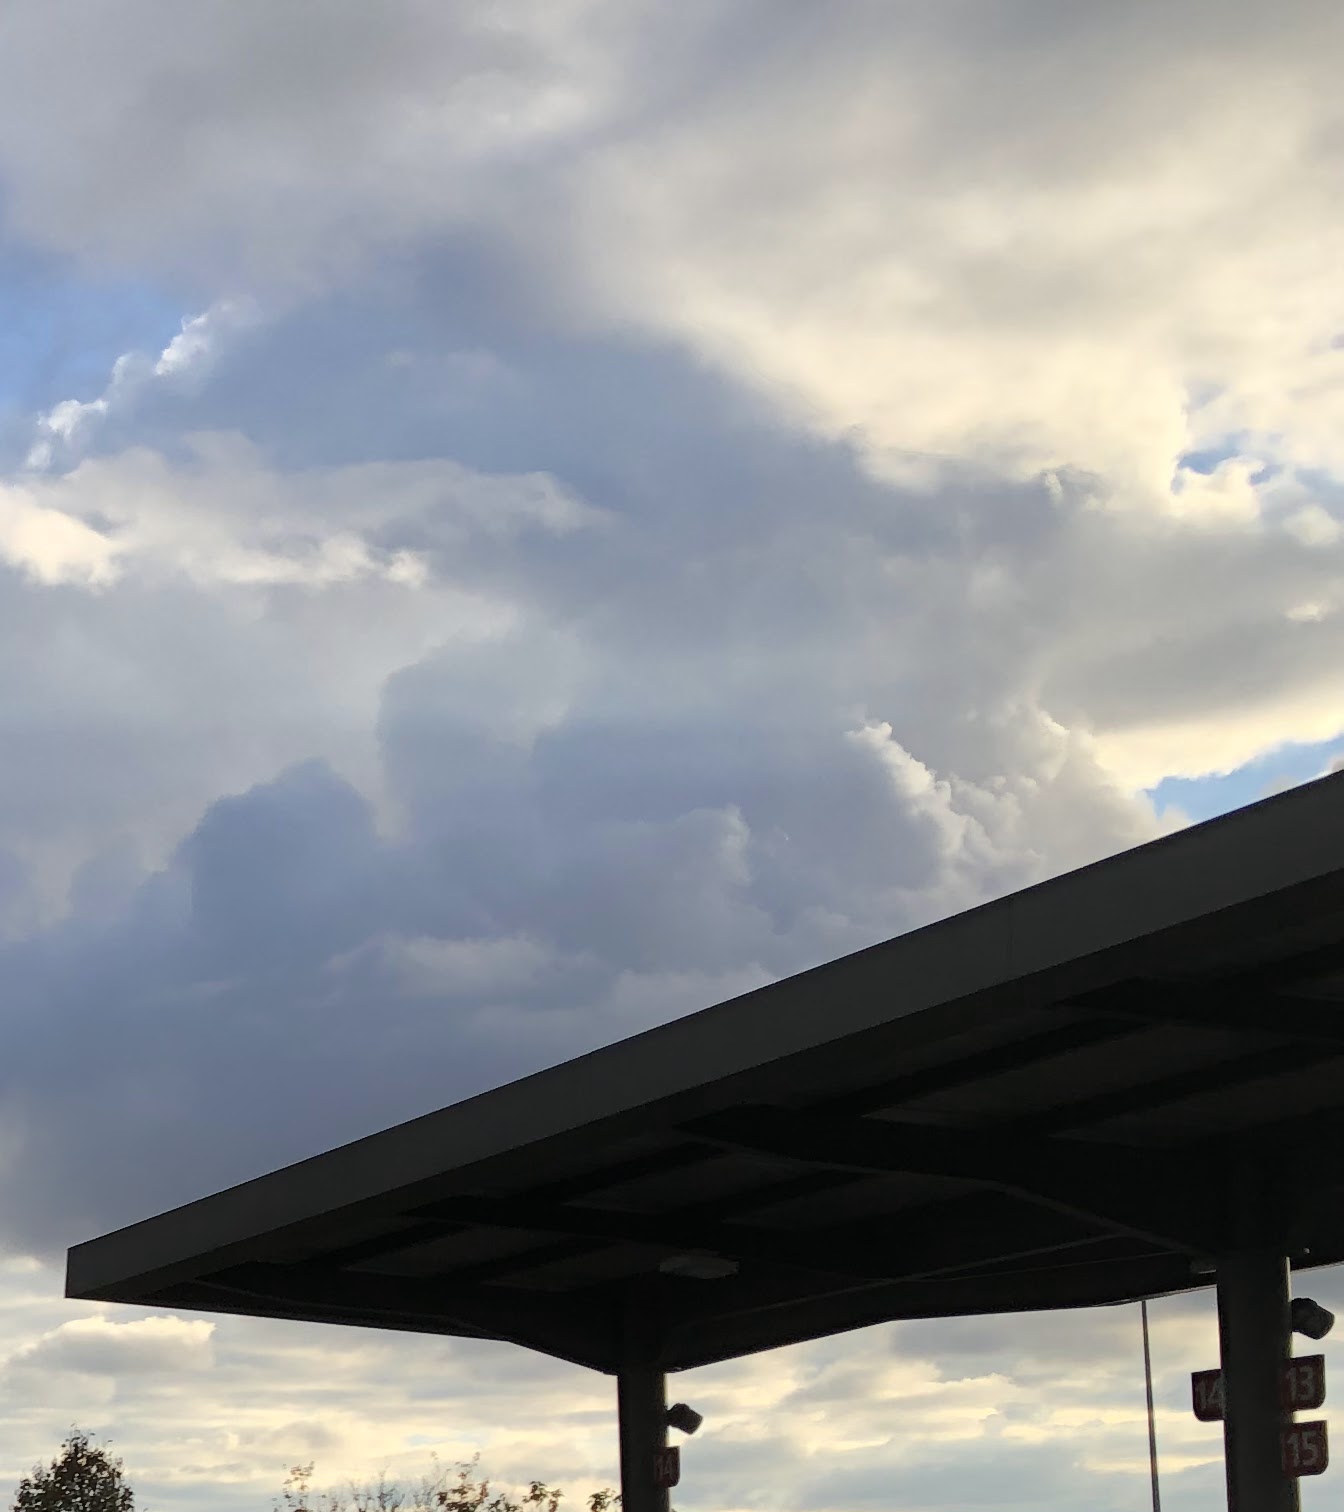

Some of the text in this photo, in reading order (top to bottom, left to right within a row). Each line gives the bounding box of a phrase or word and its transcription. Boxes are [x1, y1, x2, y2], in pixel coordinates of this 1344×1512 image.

[1195, 1374, 1226, 1411] 14
[1285, 1364, 1316, 1402] 13
[1286, 1430, 1320, 1468] 15
